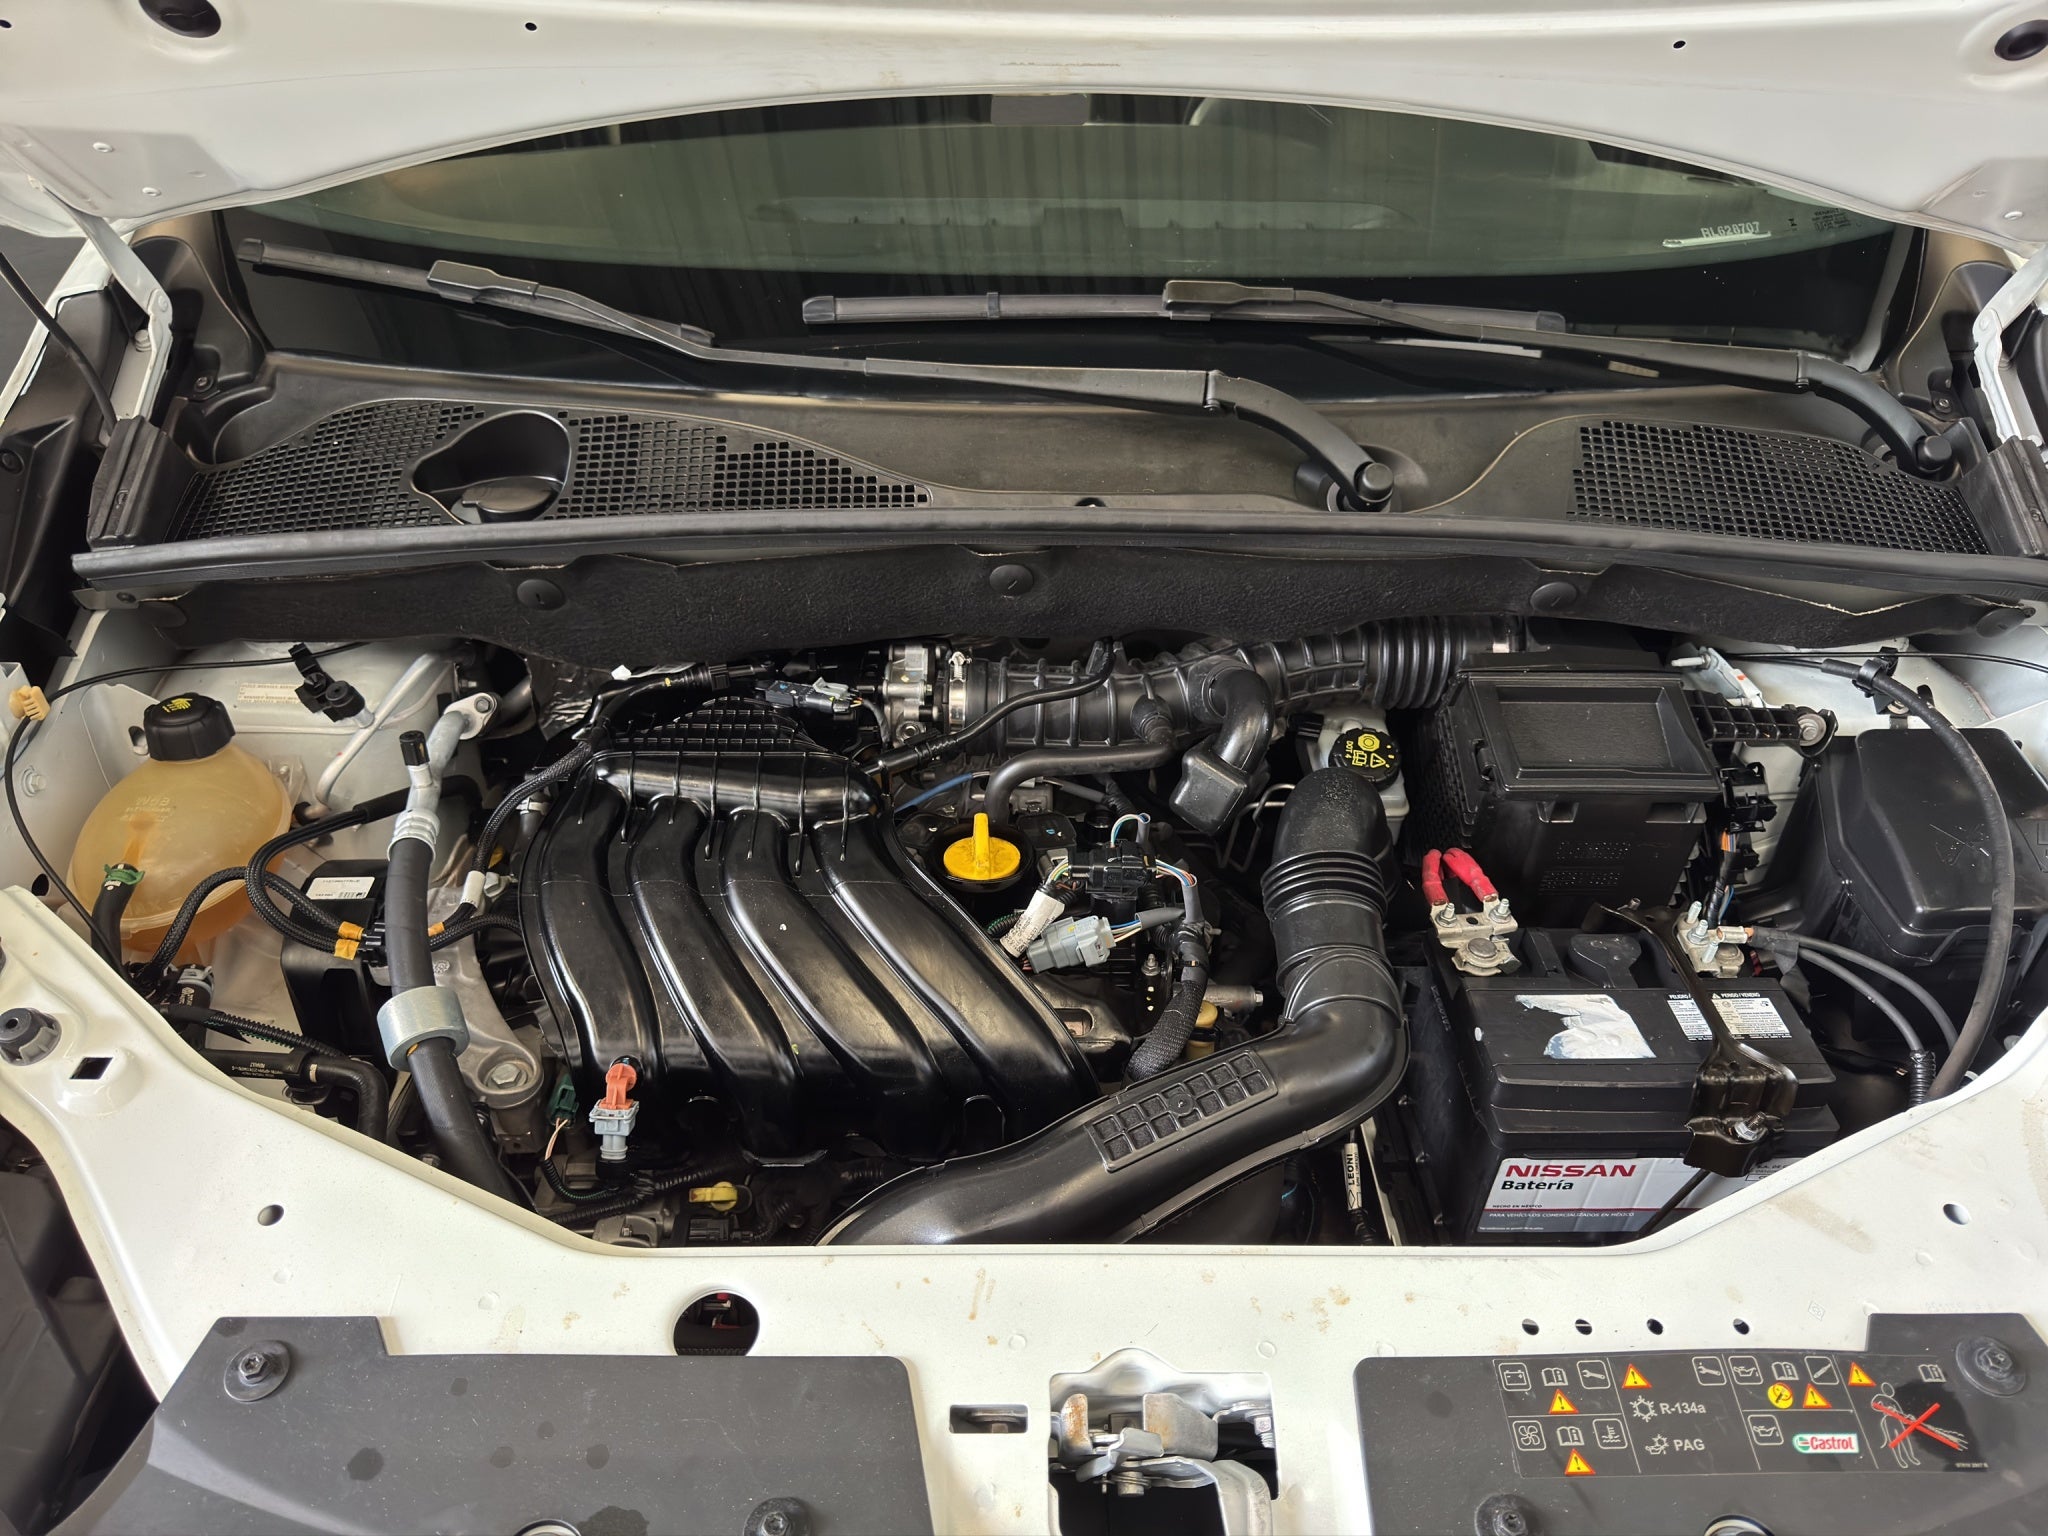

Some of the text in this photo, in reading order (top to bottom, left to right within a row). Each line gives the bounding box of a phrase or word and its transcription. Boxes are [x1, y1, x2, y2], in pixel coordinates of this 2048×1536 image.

[1345, 740, 1354, 753] DOT
[1346, 1153, 1355, 1186] LEONI
[1505, 1164, 1637, 1178] NISSAN
[1500, 1179, 1574, 1190] Batería
[1659, 1402, 1707, 1415] R-134a
[1673, 1438, 1705, 1452] PAG
[1809, 1436, 1854, 1450] Castrol
